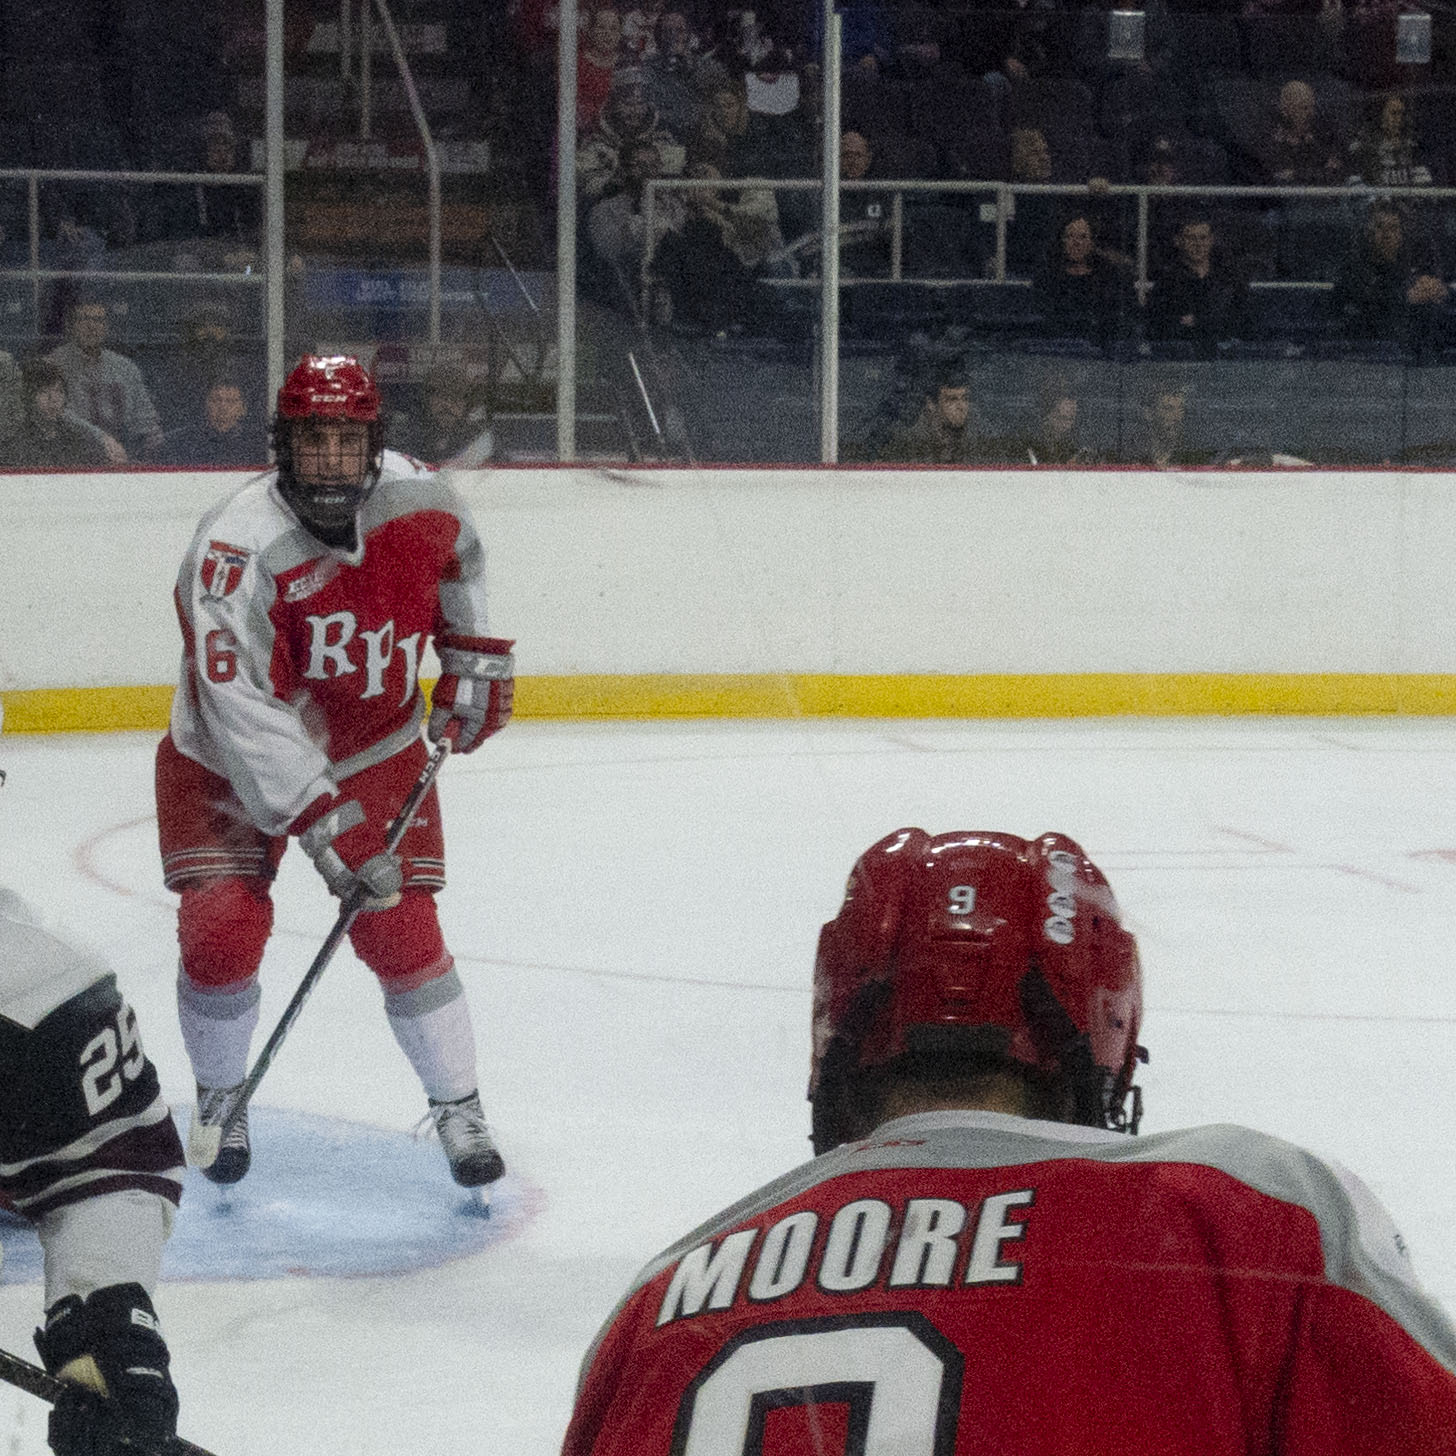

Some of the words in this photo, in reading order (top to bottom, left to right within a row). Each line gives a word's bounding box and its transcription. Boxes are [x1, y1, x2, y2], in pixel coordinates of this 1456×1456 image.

[205, 629, 238, 684] 6
[304, 610, 422, 708] RPI
[946, 884, 977, 915] 9
[79, 1001, 145, 1117] 25
[654, 1187, 1036, 1329] MOORE
